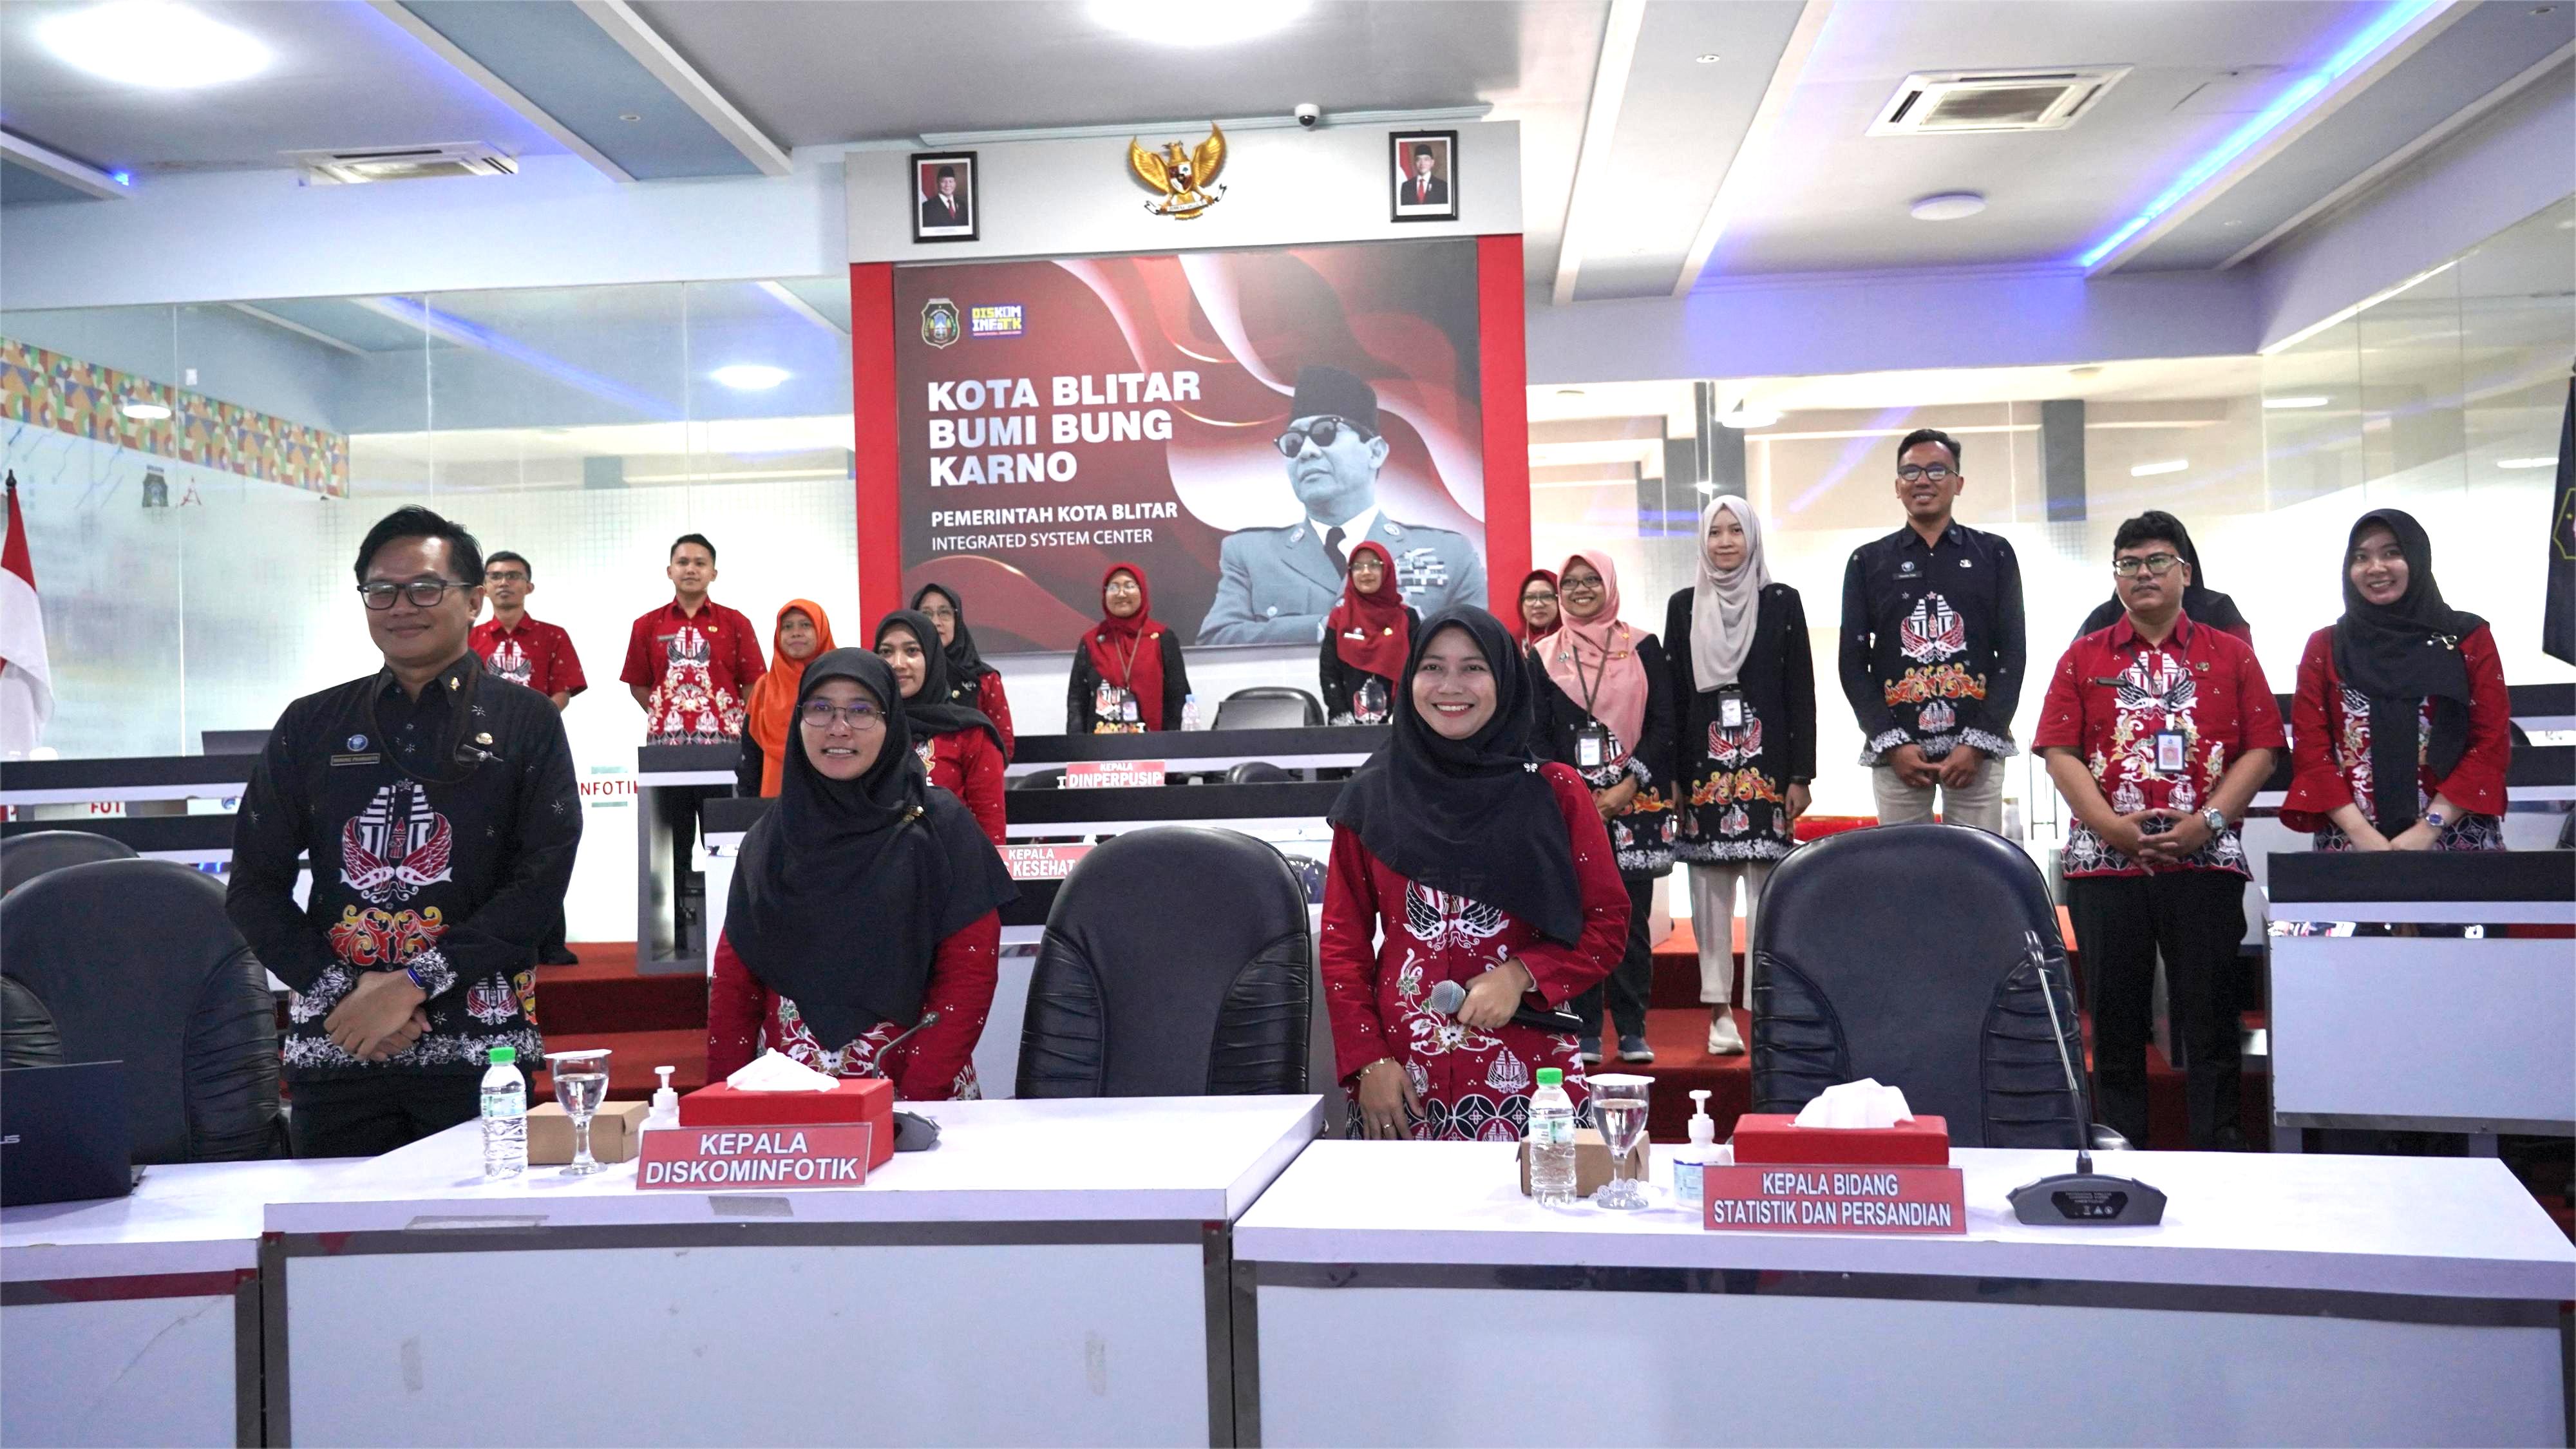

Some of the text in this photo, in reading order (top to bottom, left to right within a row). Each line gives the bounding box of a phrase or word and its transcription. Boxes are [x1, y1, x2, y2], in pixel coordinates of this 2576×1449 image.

[972, 305, 1021, 319] DISKOM
[927, 370, 1201, 412] KOTA BLITAR
[929, 409, 1173, 450] BUMI BUNG
[930, 451, 1077, 487] KARNO
[931, 502, 1179, 527] PEMERINTAH KOTA BLITAR
[931, 528, 1153, 551] INTEGRATED SYSTEM CENTER
[1100, 762, 1133, 772] KEPALA
[1069, 772, 1162, 788] DINPERPUSIP
[1009, 848, 1055, 860] KEPALA
[699, 1132, 808, 1156] KEPALA
[645, 1158, 859, 1184] DISKOMINFOTIK
[1762, 1172, 1899, 1196] KEPALA BIDANG
[1713, 1199, 1952, 1226] STATISTIK DAN PERSANDIAN
